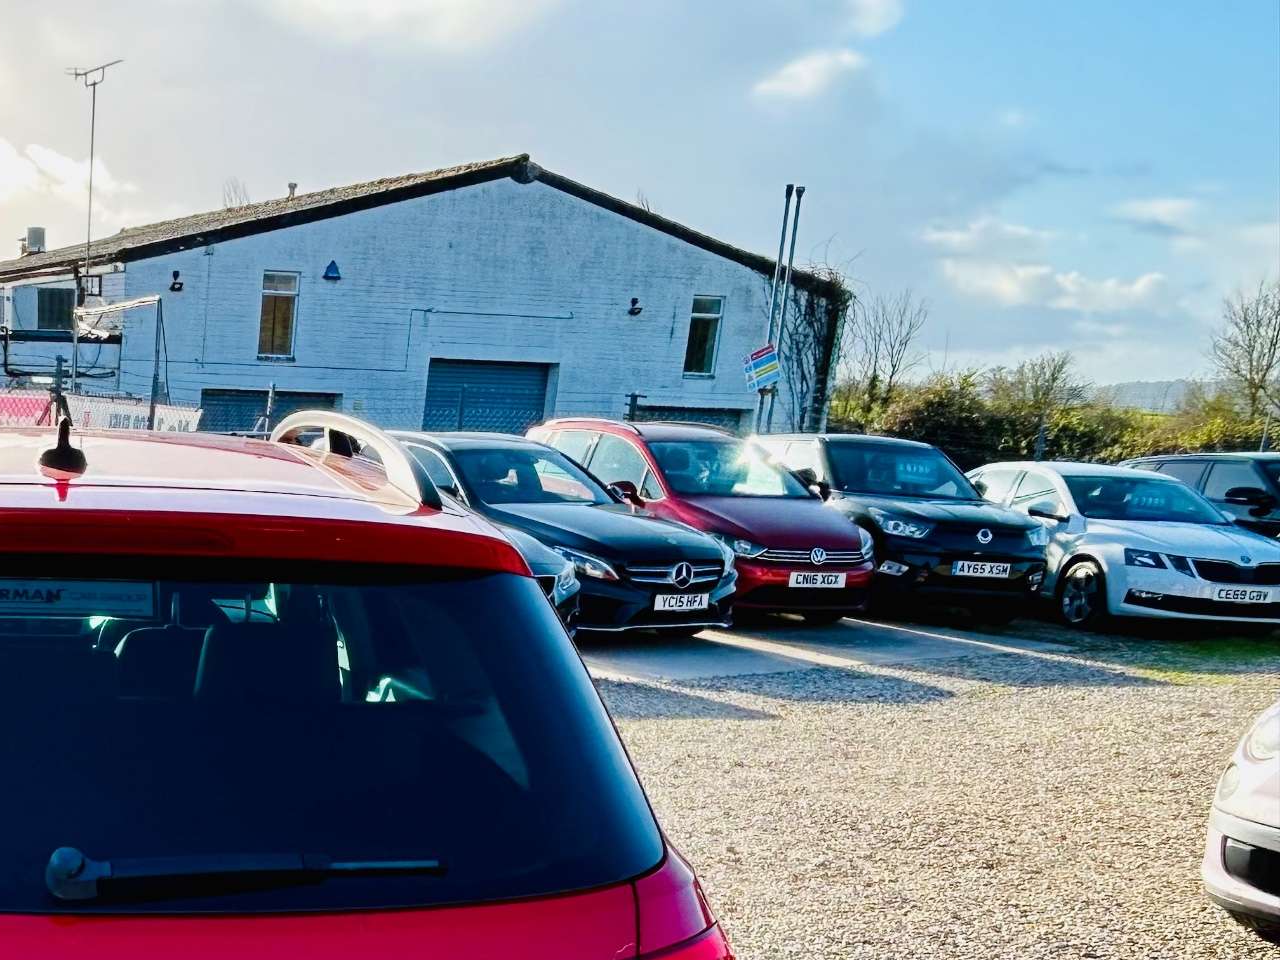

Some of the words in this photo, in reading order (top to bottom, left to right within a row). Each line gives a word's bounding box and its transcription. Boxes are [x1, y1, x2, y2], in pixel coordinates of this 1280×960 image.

[958, 562, 986, 573] AY65
[987, 563, 1009, 575] XSM
[795, 573, 819, 585] CN16
[820, 574, 840, 585] XGX
[1217, 588, 1248, 600] CE69
[662, 595, 685, 608] YC15
[685, 594, 703, 607] HFA
